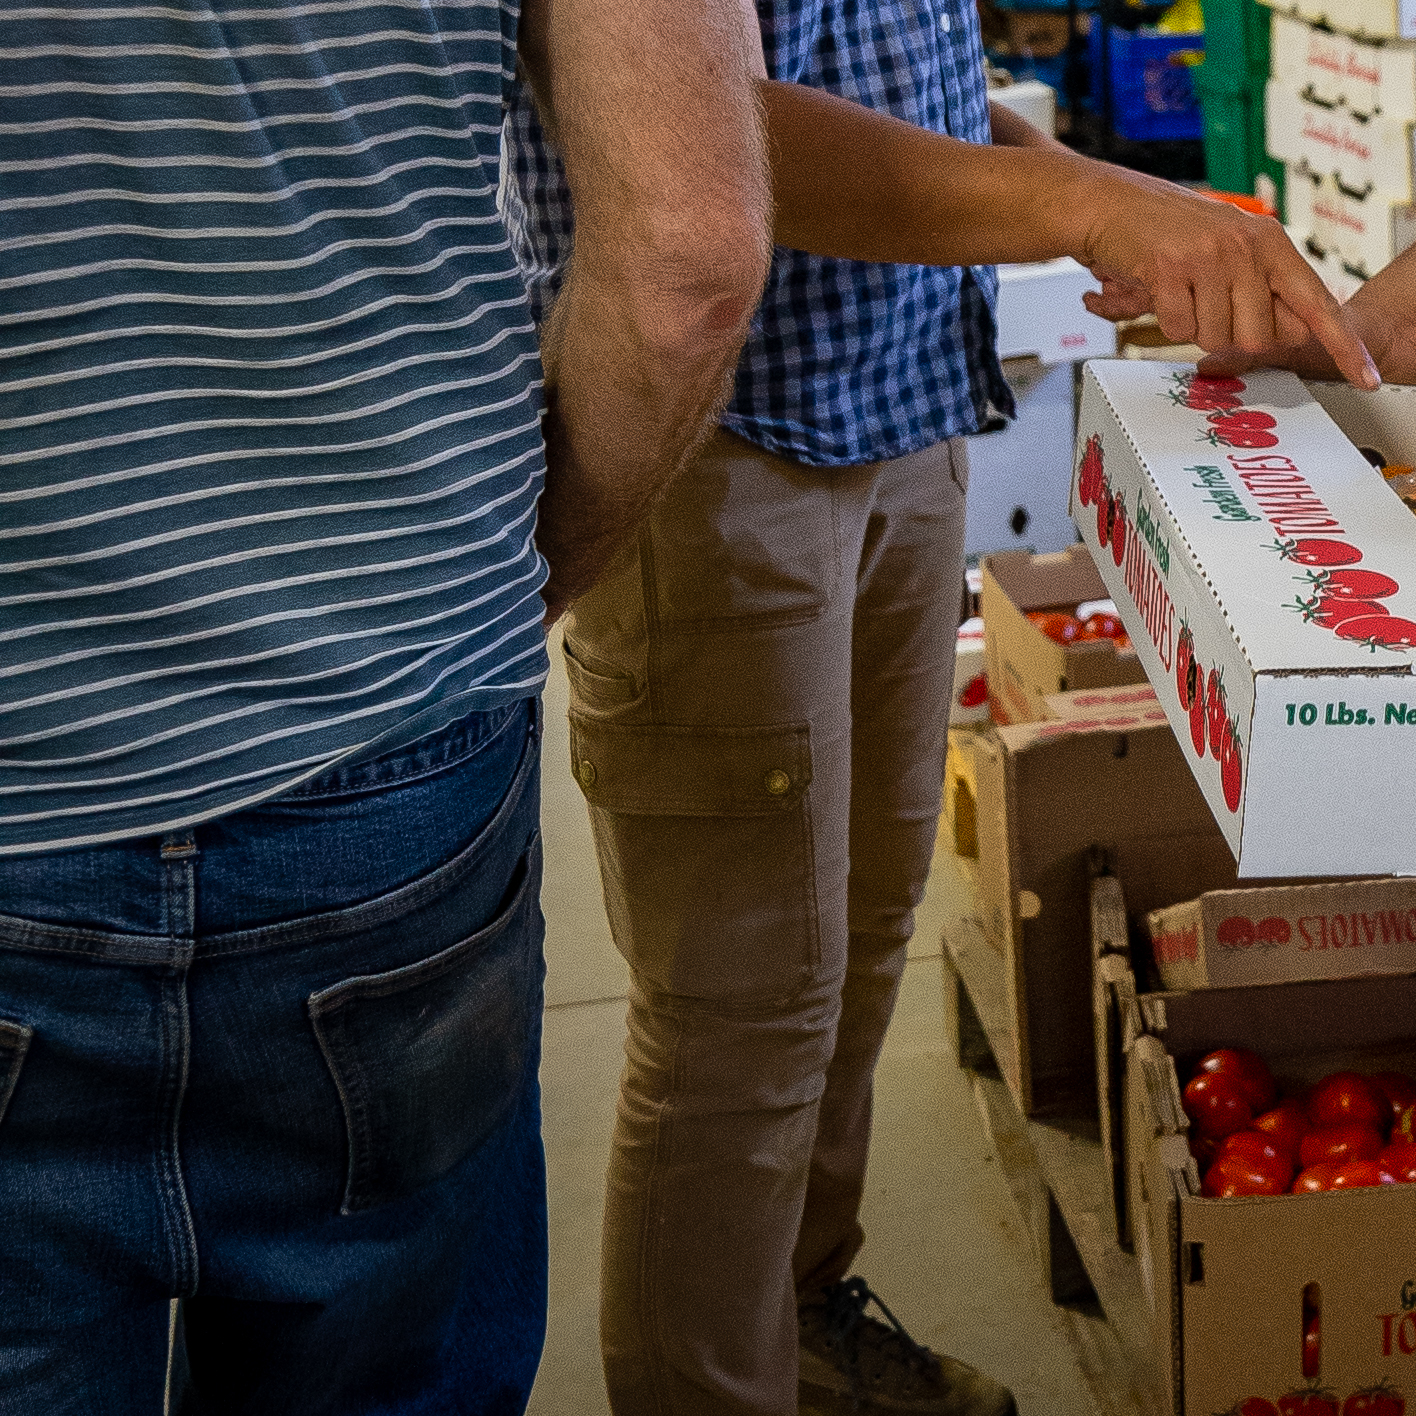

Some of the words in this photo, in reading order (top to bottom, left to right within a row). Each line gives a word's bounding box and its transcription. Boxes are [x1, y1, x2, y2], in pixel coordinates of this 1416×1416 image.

[1183, 465, 1232, 489] Fresh
[1202, 489, 1262, 522] Garden
[1226, 454, 1346, 537] TOMATOES
[1136, 487, 1155, 552] Garden
[1154, 518, 1170, 581] Fresh
[1124, 518, 1175, 673] TOMATOES
[1285, 703, 1318, 726] 10
[1325, 702, 1376, 726] Lbs.
